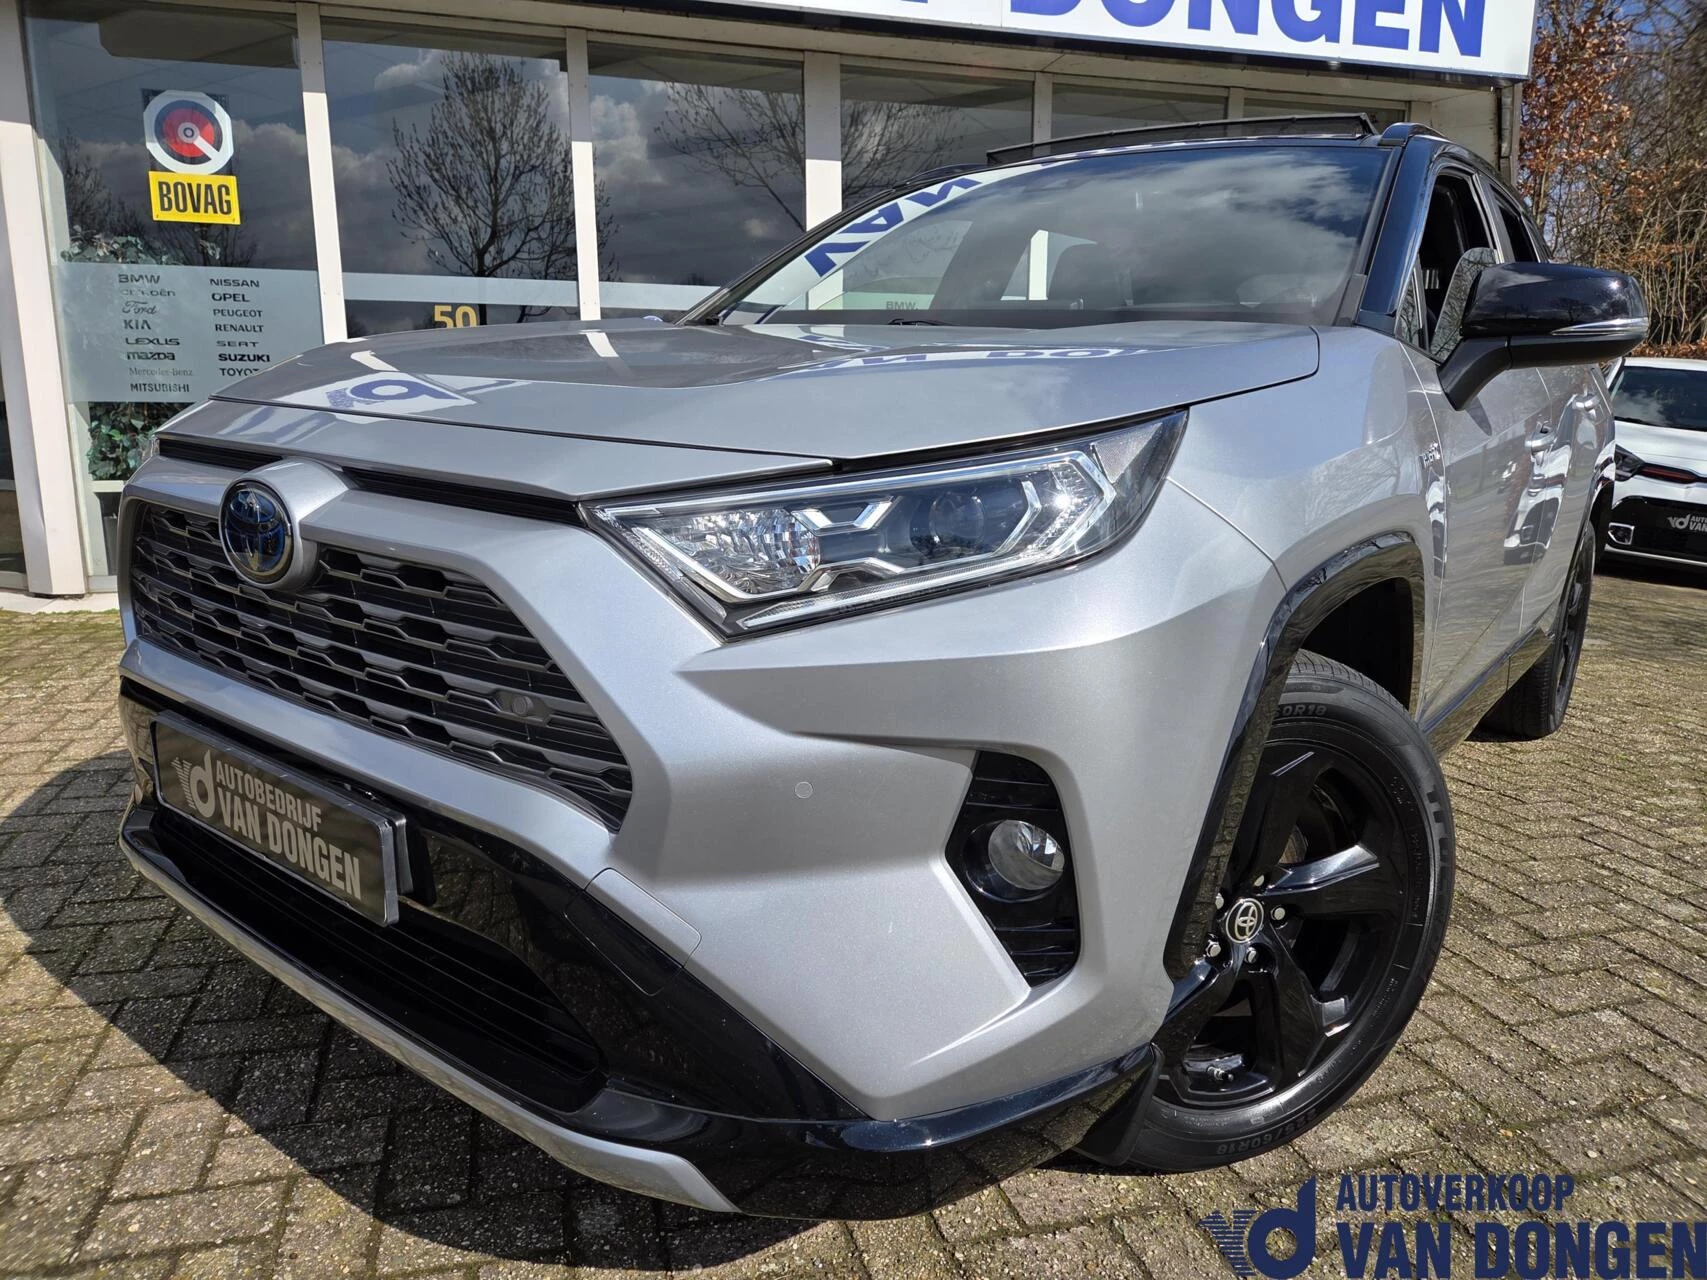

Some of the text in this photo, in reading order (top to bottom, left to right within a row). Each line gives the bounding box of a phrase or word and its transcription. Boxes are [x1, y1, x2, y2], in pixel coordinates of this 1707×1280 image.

[158, 181, 232, 215] BOVAG
[118, 274, 160, 284] BMW
[209, 278, 260, 288] NISSAN
[211, 293, 250, 302] OPEL
[122, 300, 158, 315] Ford
[213, 309, 263, 318] PEUGEOT
[434, 304, 477, 328] 50
[124, 320, 151, 330] KIA
[215, 324, 264, 333] RENAULT
[125, 337, 180, 346] LEXUS
[216, 340, 260, 348] SEAT
[218, 353, 270, 362] SUZUKI
[220, 368, 259, 377] TOYO
[130, 383, 190, 392] MITSUBISHI
[216, 760, 322, 832] AUTOBEDRIJF
[218, 787, 361, 900] VAN DONGEN
